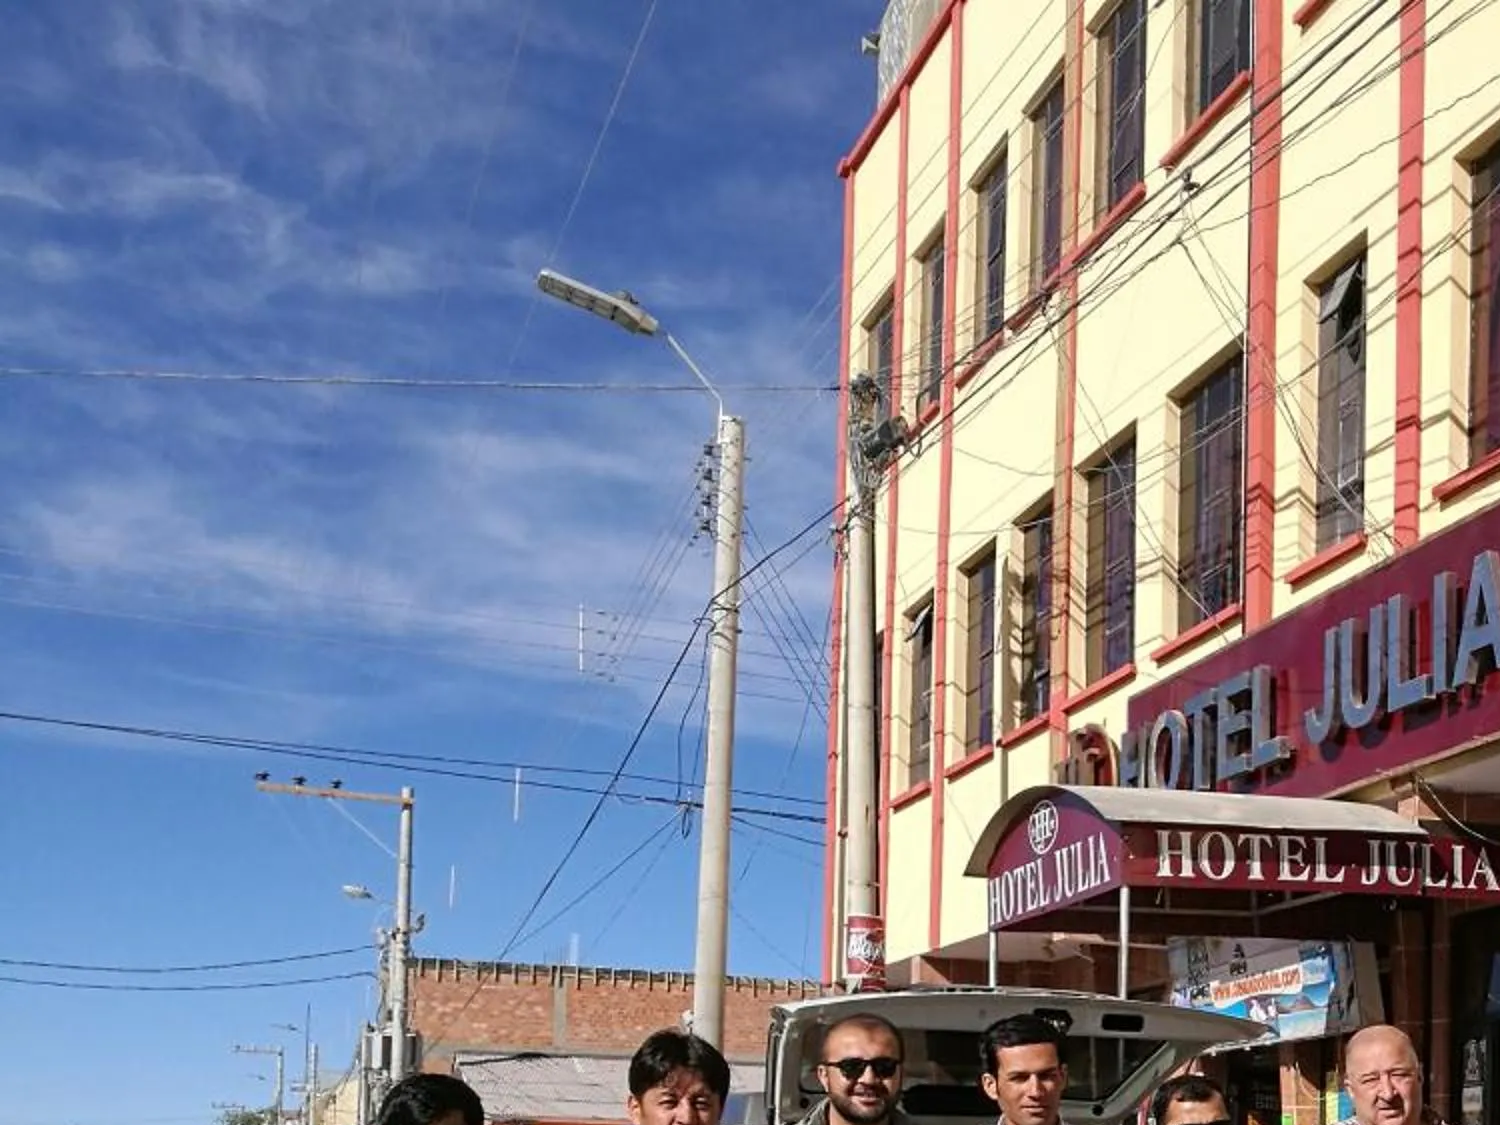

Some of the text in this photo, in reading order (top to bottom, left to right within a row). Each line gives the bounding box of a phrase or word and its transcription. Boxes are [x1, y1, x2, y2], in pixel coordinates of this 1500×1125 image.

[1120, 664, 1294, 789] HOTEL
[988, 831, 1111, 926] HOTEL JULIA
[1156, 829, 1500, 891] HOTEL JULIA
